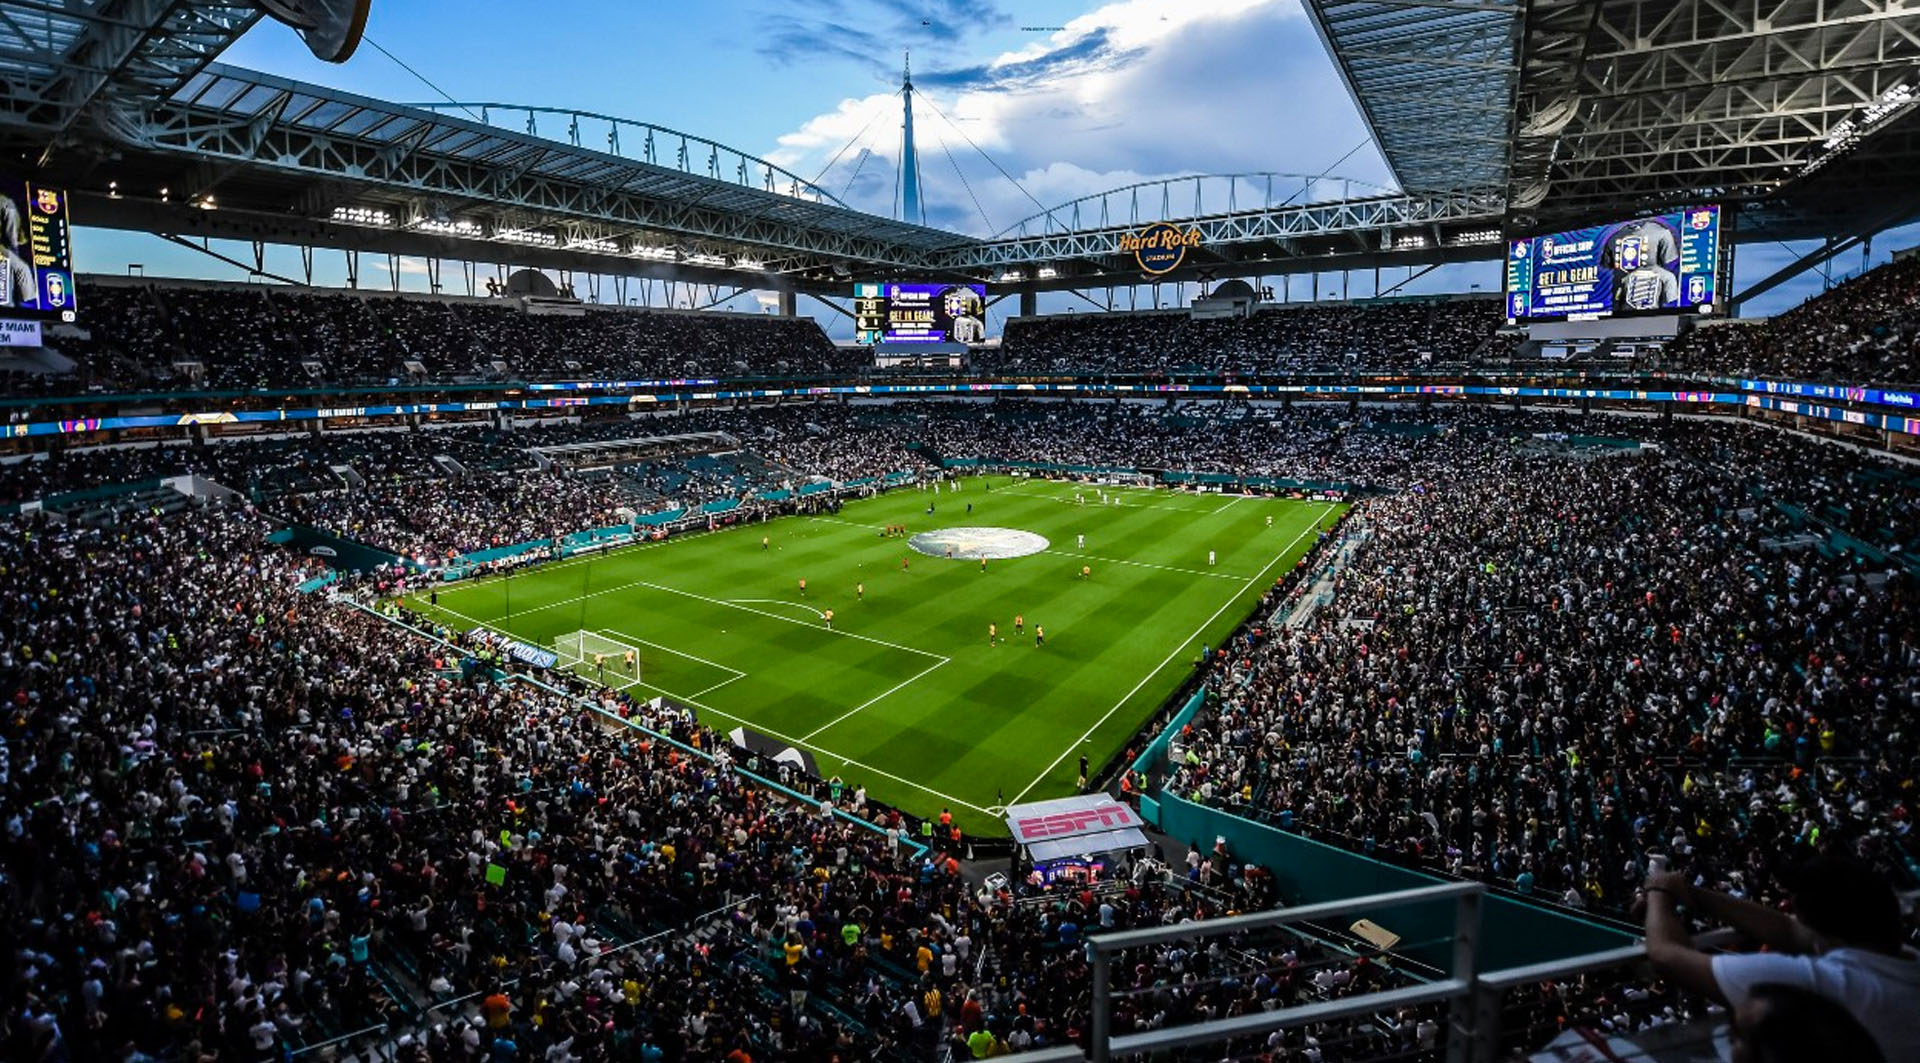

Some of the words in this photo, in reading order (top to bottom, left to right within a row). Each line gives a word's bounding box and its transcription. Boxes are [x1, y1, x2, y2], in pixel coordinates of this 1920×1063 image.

[1120, 230, 1160, 251] Hard
[1161, 228, 1202, 251] Rock
[1146, 253, 1175, 262] STADIUM
[1538, 271, 1555, 285] GET
[1557, 270, 1567, 283] IN
[1570, 266, 1598, 282] GEAR!
[5, 322, 36, 333] MIAMI
[1018, 807, 1130, 838] ESPN
